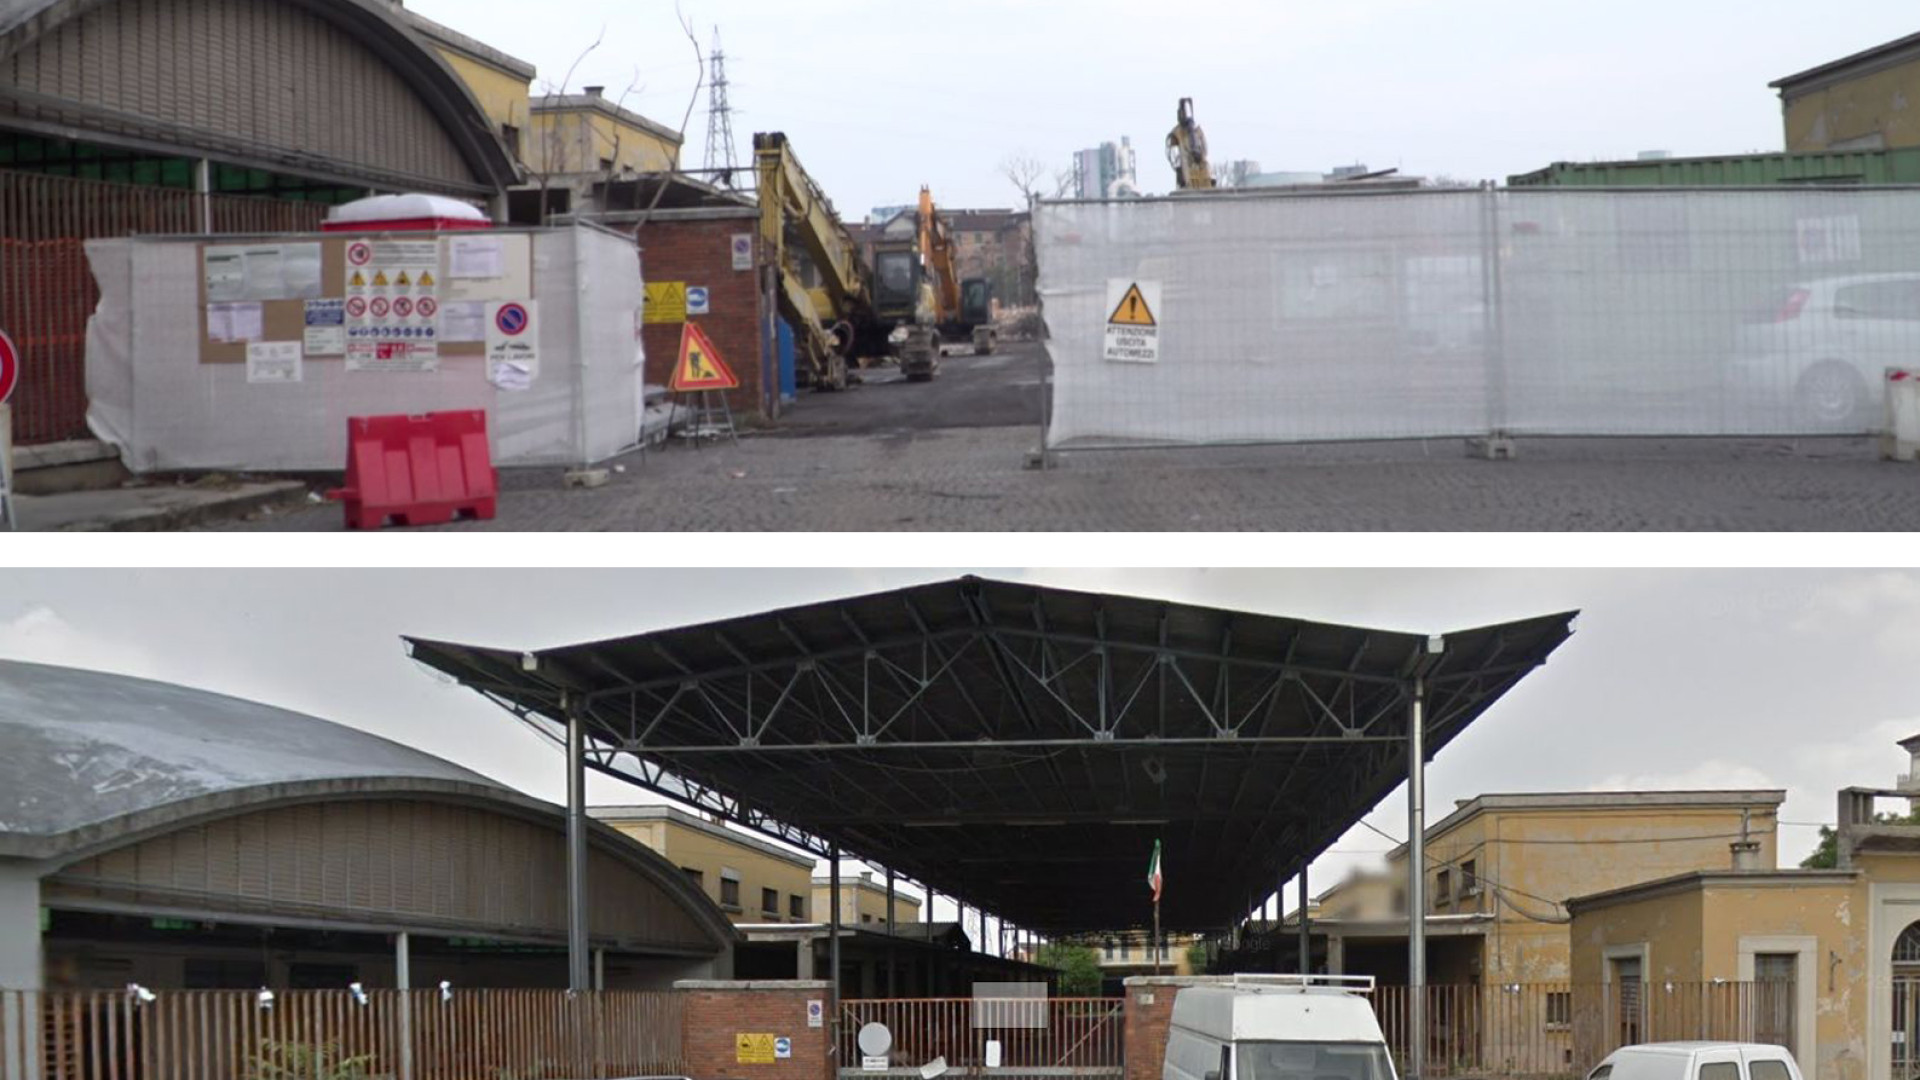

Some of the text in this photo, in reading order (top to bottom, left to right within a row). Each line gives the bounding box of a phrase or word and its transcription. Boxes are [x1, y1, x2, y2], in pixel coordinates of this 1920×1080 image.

[1107, 327, 1156, 337] ATTENZIONE
[1116, 337, 1146, 346] USCITA
[1107, 347, 1154, 358] AUTOMEZZI
